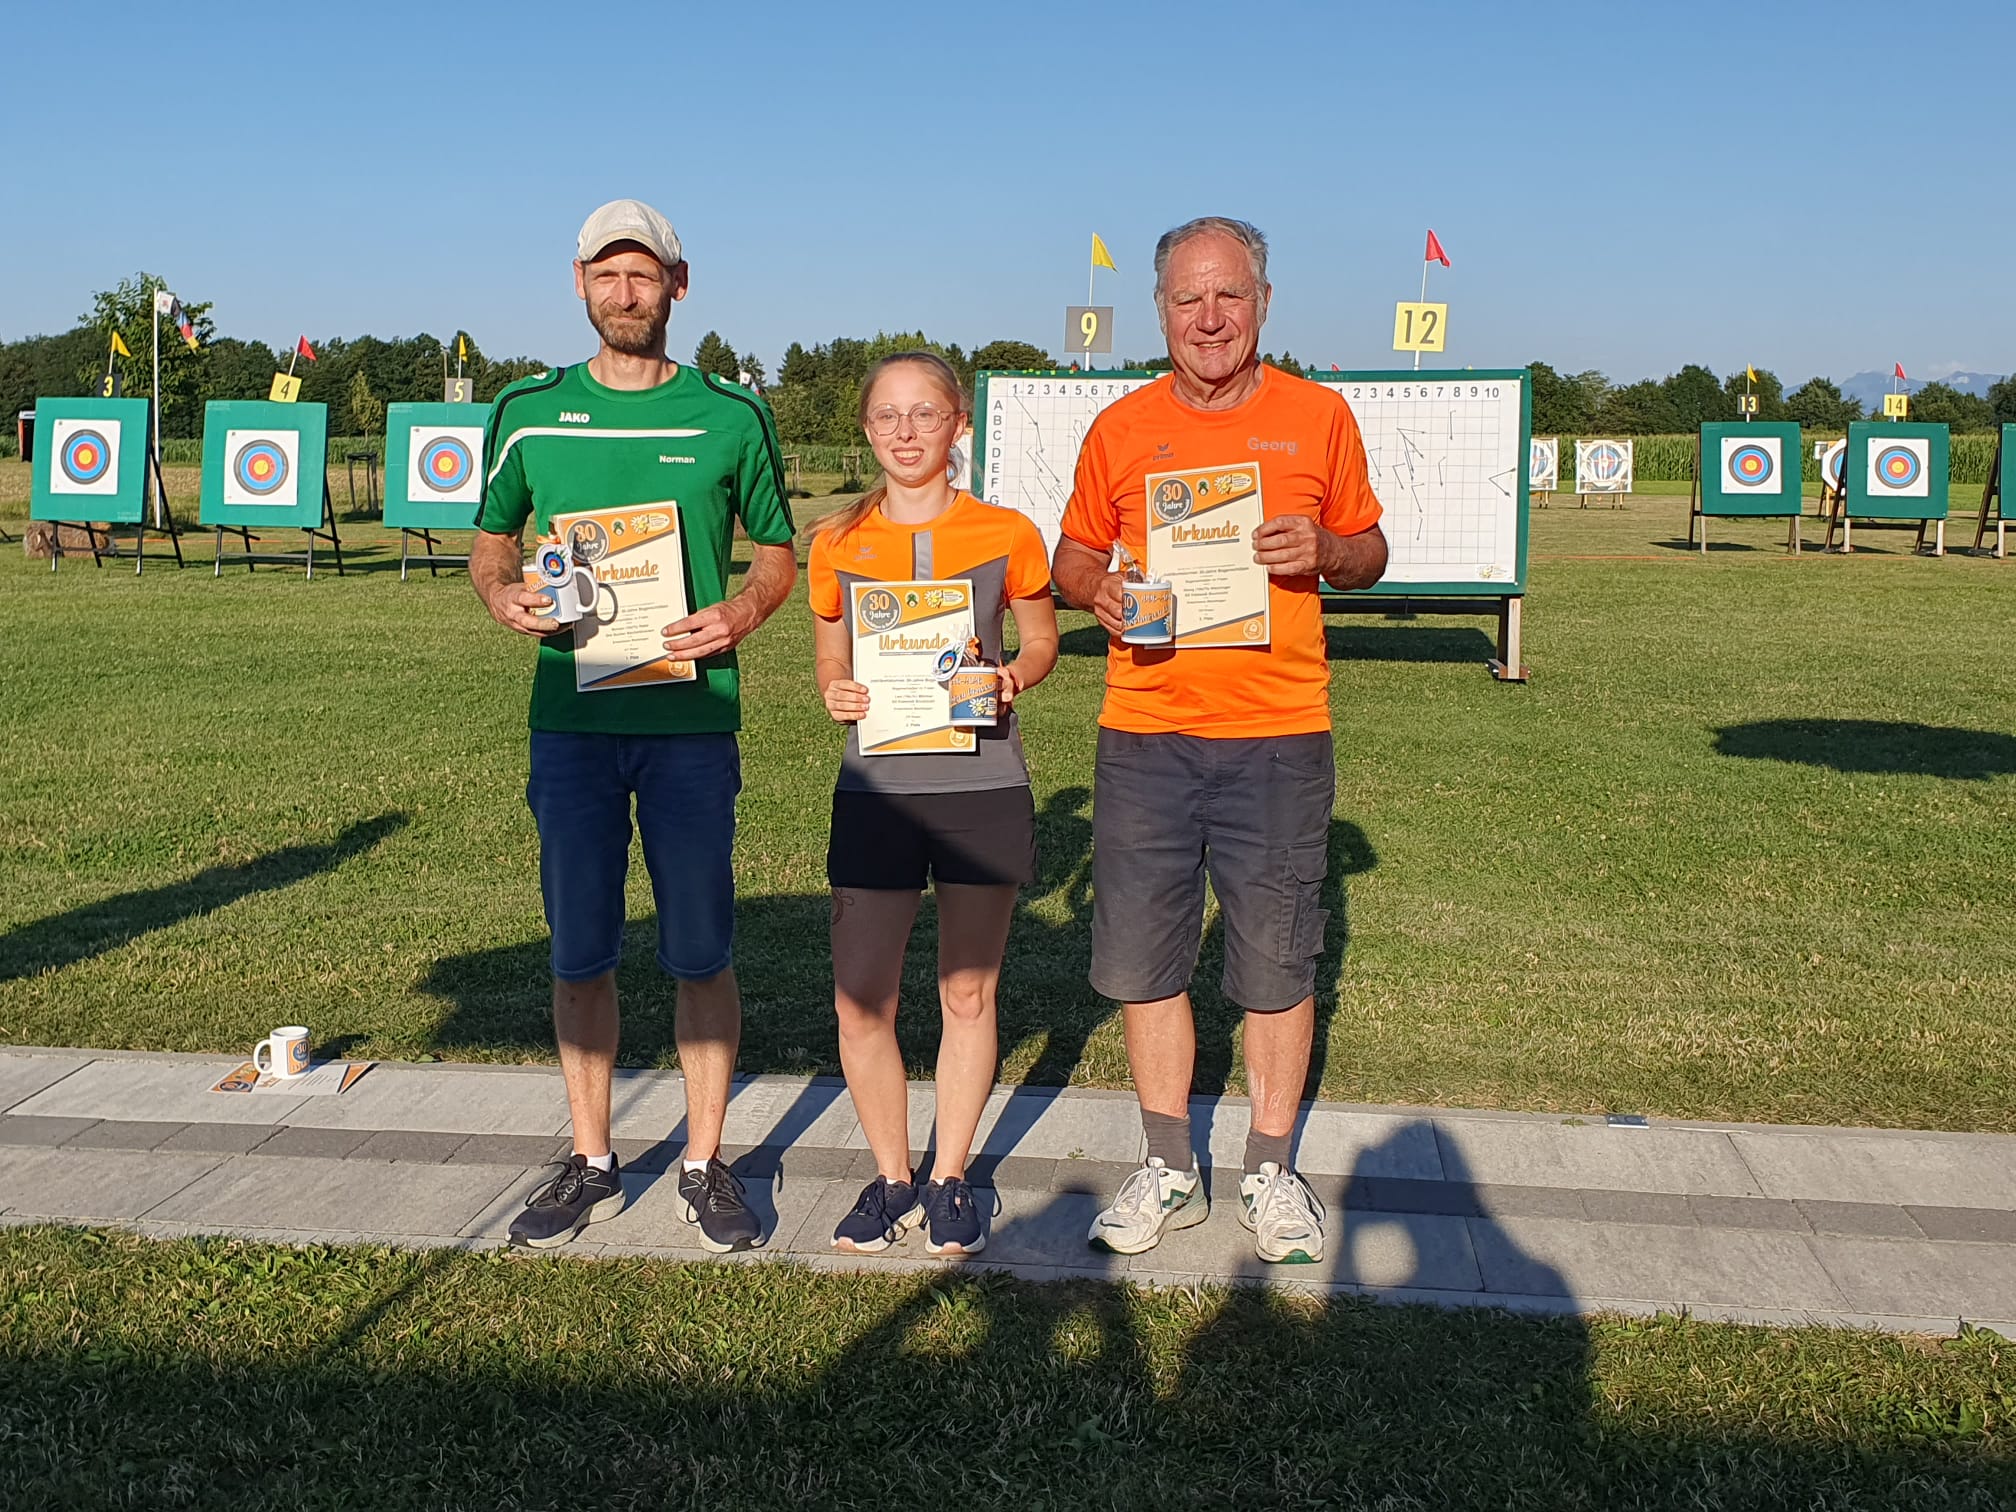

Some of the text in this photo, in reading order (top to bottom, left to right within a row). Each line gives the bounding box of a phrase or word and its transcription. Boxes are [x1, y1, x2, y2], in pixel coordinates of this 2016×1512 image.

[1081, 312, 1097, 347] 9
[1404, 310, 1437, 344] 12
[103, 375, 114, 397] 3
[281, 380, 290, 400] 4
[453, 381, 464, 402] 5
[1012, 384, 1129, 395] 1 2 3 4 5 6 7 8
[1353, 388, 1361, 399] 2
[1370, 387, 1377, 398] 3
[1386, 387, 1394, 398] 4
[1403, 387, 1411, 398] 5
[1420, 387, 1427, 398] 6
[1436, 387, 1444, 398] 7
[1453, 387, 1461, 398] 8
[1470, 386, 1478, 397] 9
[1484, 387, 1499, 398] 10
[993, 400, 1003, 410] A
[1741, 396, 1758, 412] 13
[1887, 397, 1903, 412] 14
[559, 412, 590, 423] JAKO
[993, 415, 1002, 426] B
[993, 430, 1002, 441] C
[1248, 437, 1297, 455] Georg
[659, 455, 695, 464] Norman
[992, 448, 1001, 458] D
[991, 463, 1000, 473] E
[991, 478, 999, 488] F
[1162, 483, 1182, 502] 30
[990, 495, 999, 505] G
[1162, 501, 1183, 512] Jahre
[1172, 520, 1240, 542] Urkunde
[869, 593, 890, 611] 30
[869, 610, 891, 620] Jahre
[879, 633, 950, 651] Urkunde
